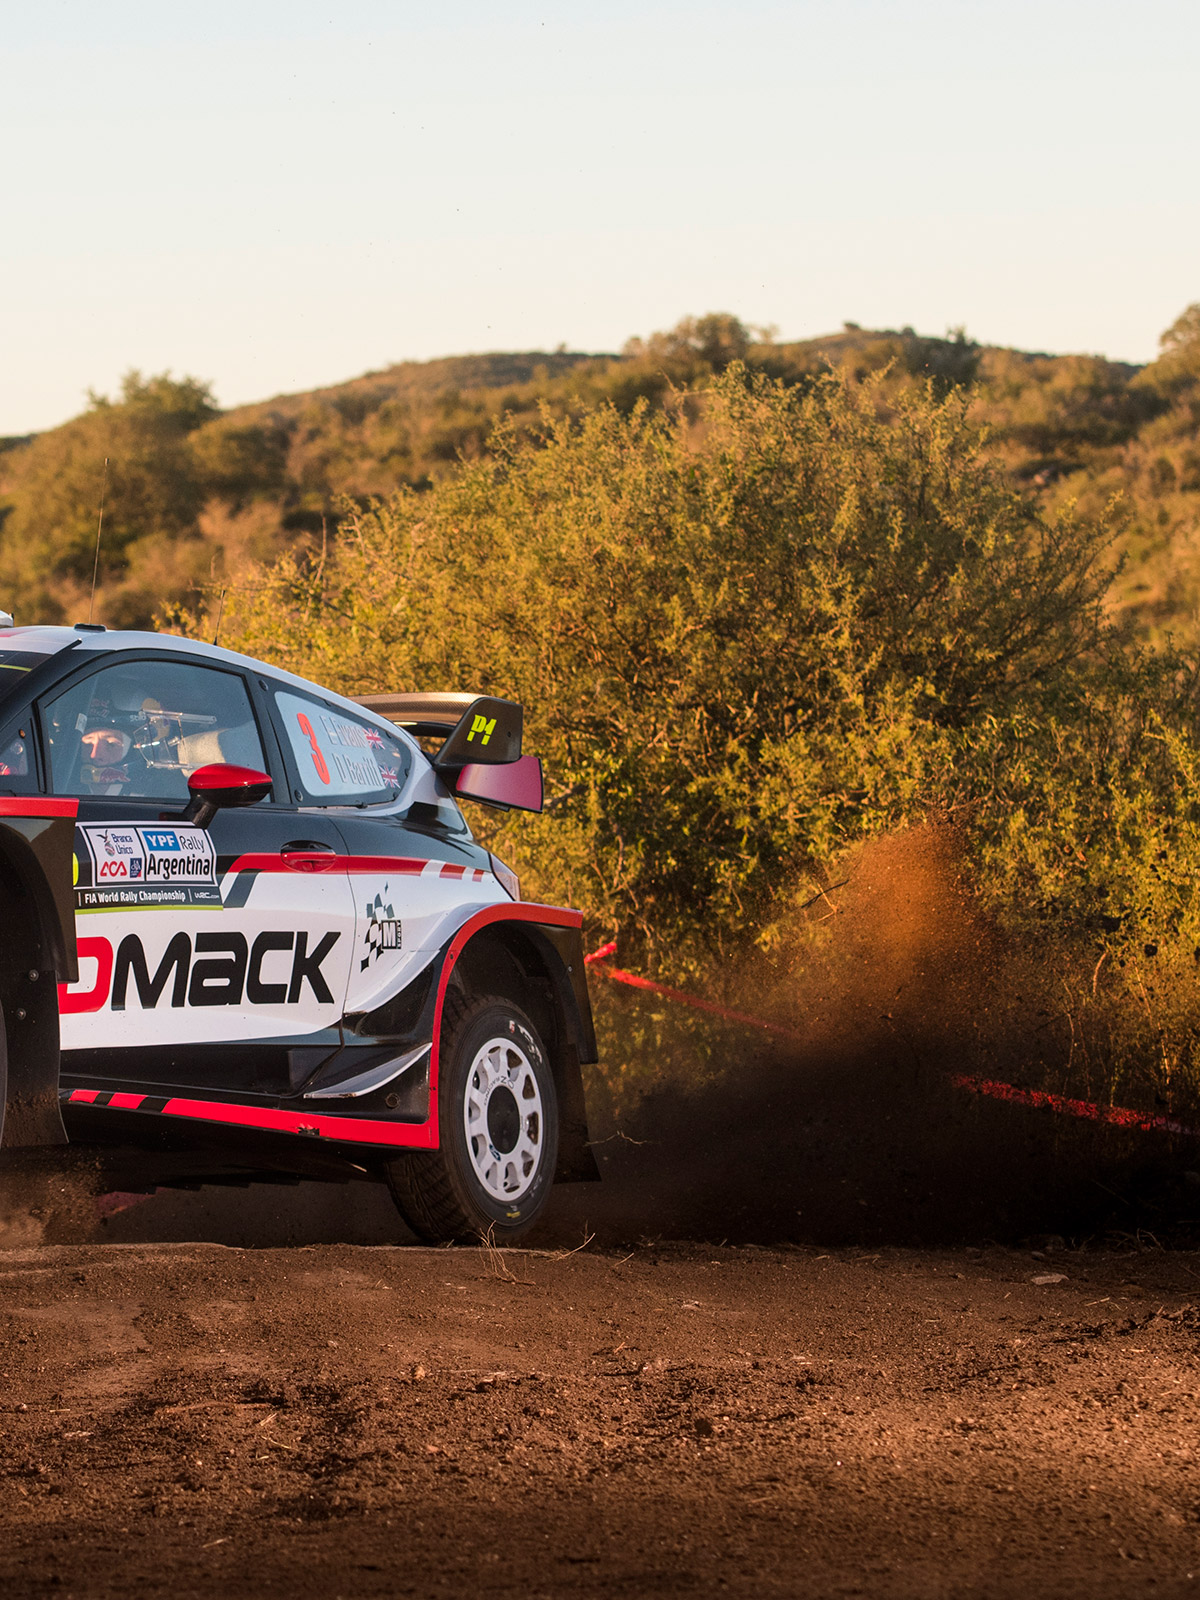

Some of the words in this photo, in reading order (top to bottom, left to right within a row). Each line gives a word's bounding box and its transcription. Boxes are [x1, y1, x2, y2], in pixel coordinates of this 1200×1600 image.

[296, 712, 331, 785] 3
[111, 833, 133, 843] Branca
[146, 835, 175, 847] YPF
[179, 835, 204, 853] Rally
[100, 860, 127, 877] ACA
[147, 853, 210, 880] Argentina
[85, 893, 97, 904] FIA
[98, 891, 119, 903] World
[120, 891, 138, 903] Rally
[139, 890, 186, 902] Championship
